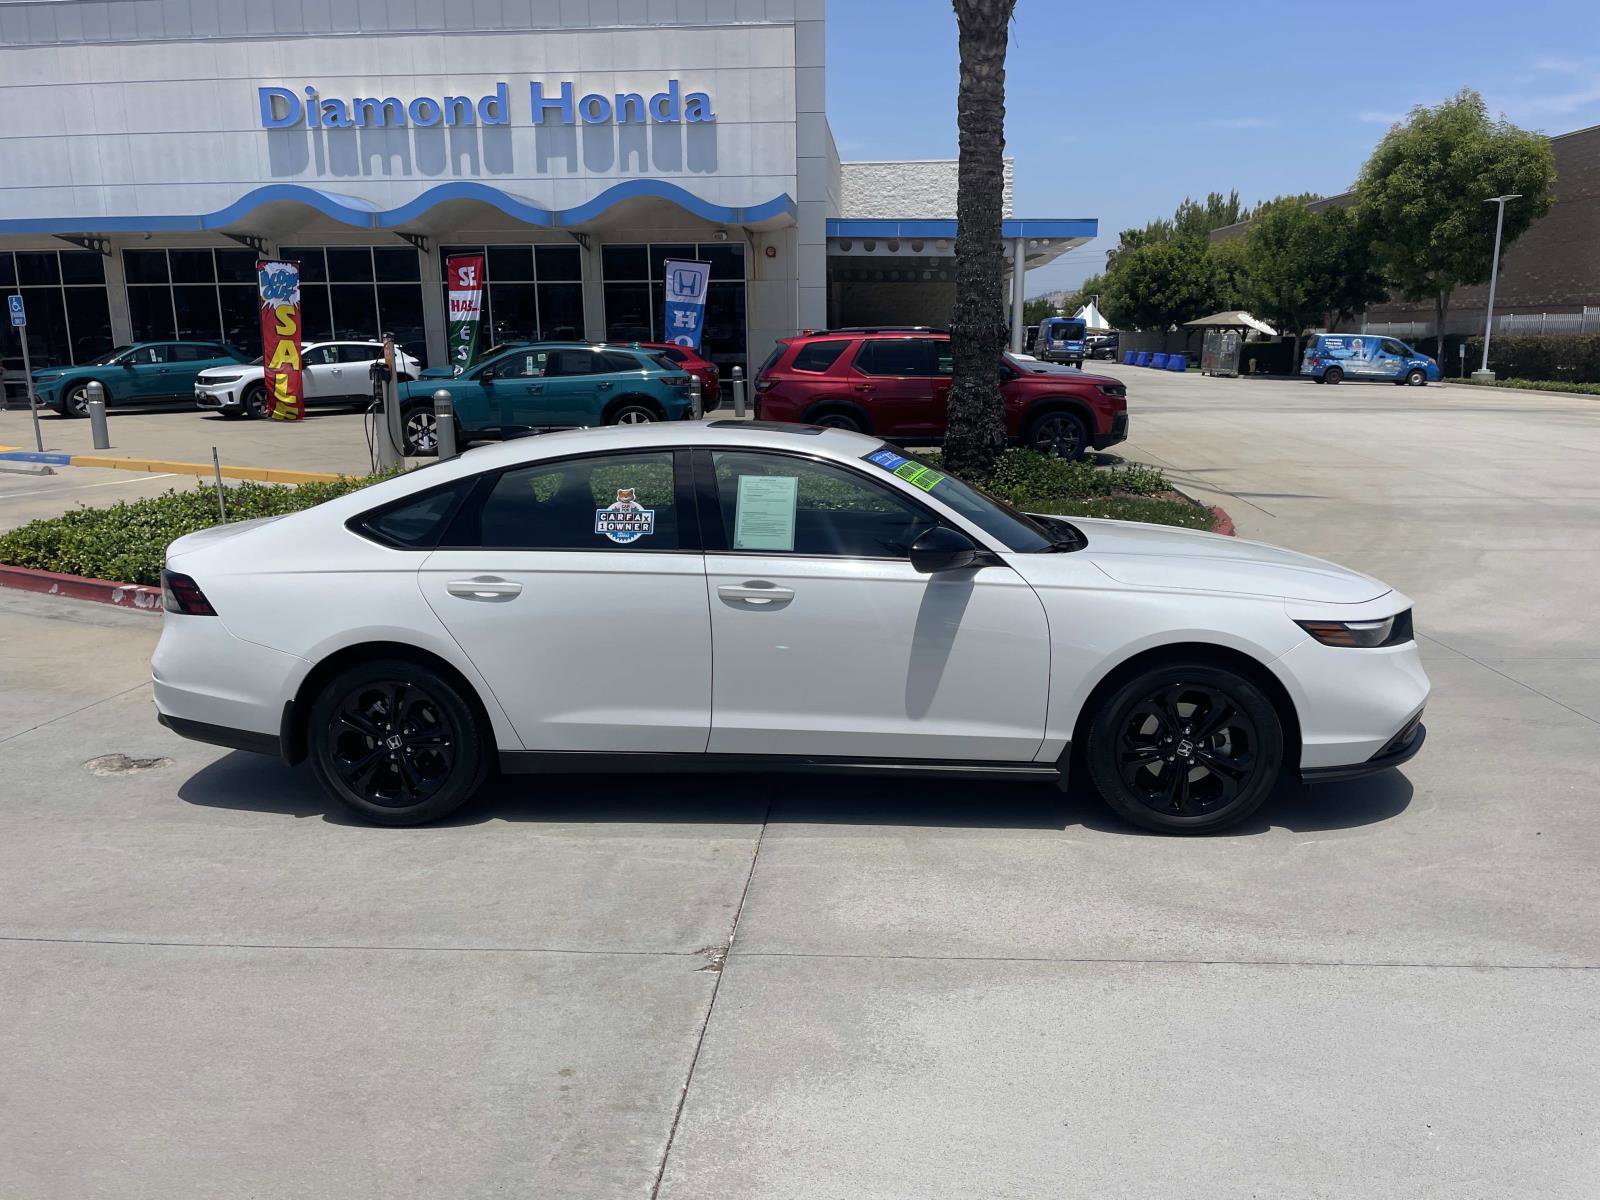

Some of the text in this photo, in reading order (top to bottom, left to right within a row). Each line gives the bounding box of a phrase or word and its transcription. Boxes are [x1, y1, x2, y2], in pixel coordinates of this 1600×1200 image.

[258, 79, 717, 129] Diamond Honda
[458, 266, 477, 287] SE
[268, 304, 300, 420] SALE
[600, 513, 650, 522] CARFAX
[608, 523, 649, 531] OWNER
